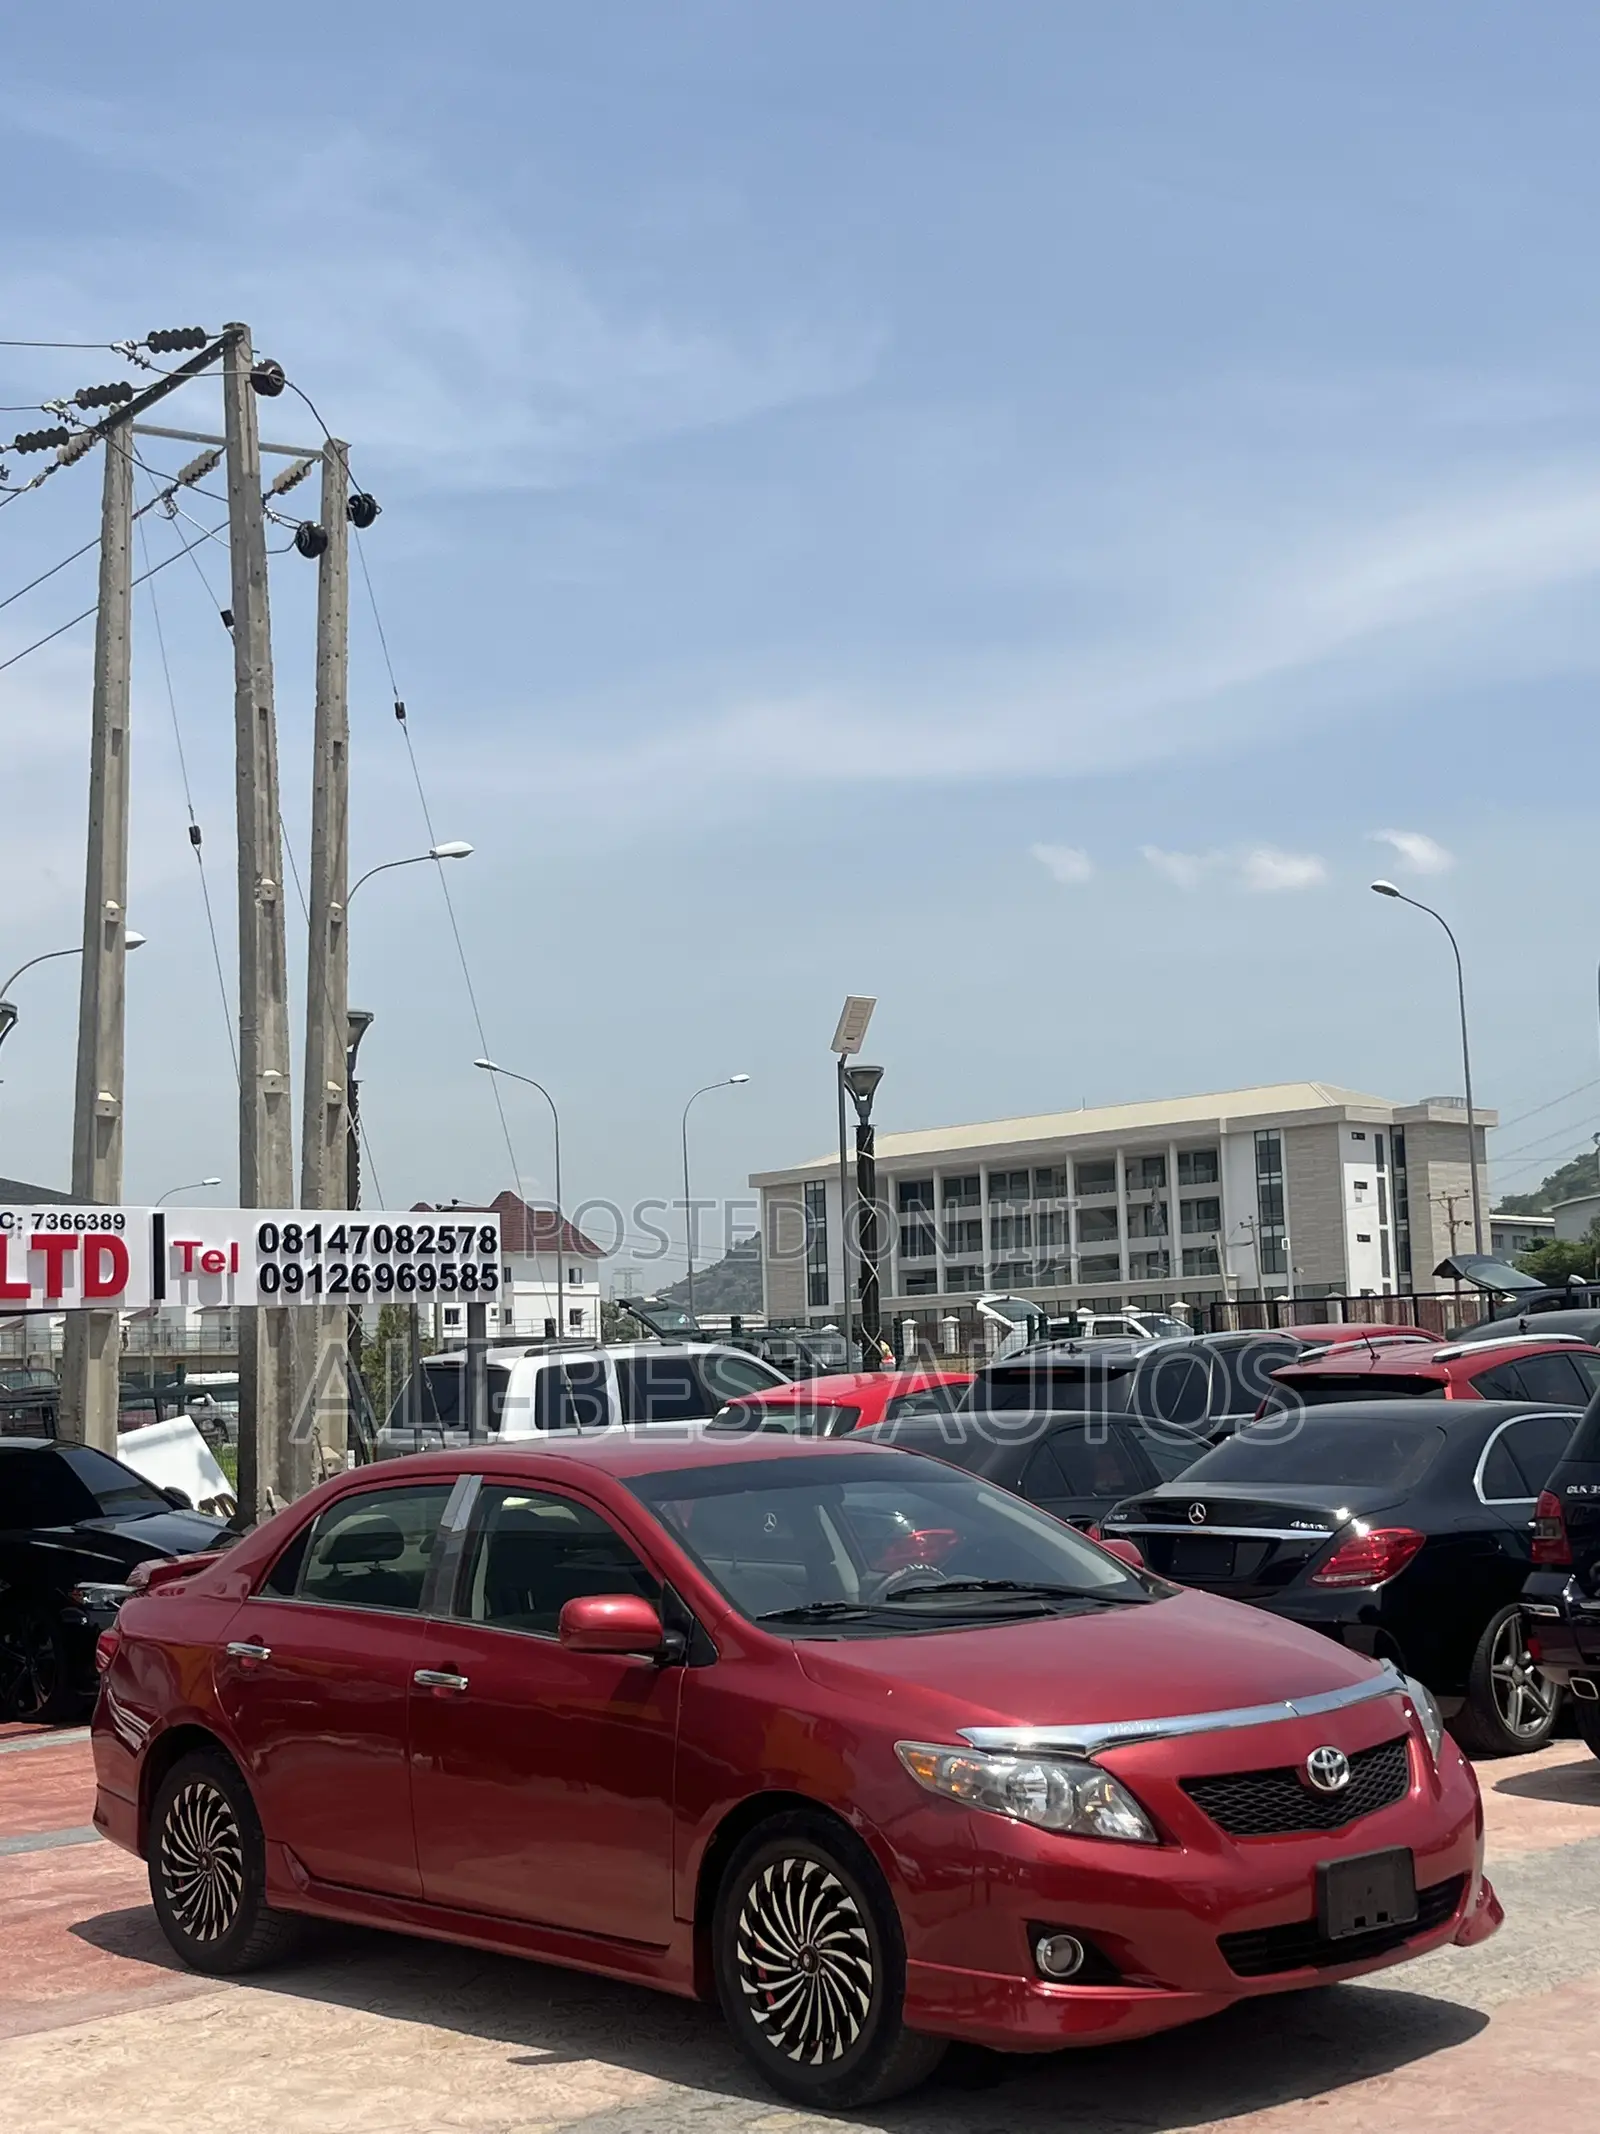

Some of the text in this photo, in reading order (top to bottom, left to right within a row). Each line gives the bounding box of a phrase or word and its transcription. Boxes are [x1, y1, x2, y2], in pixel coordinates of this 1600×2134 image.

[31, 1213, 126, 1231] 7366389
[258, 1222, 498, 1255] 08147082578
[0, 1233, 130, 1299] LTD
[173, 1240, 239, 1274] Tel
[259, 1261, 499, 1294] 09126969585
